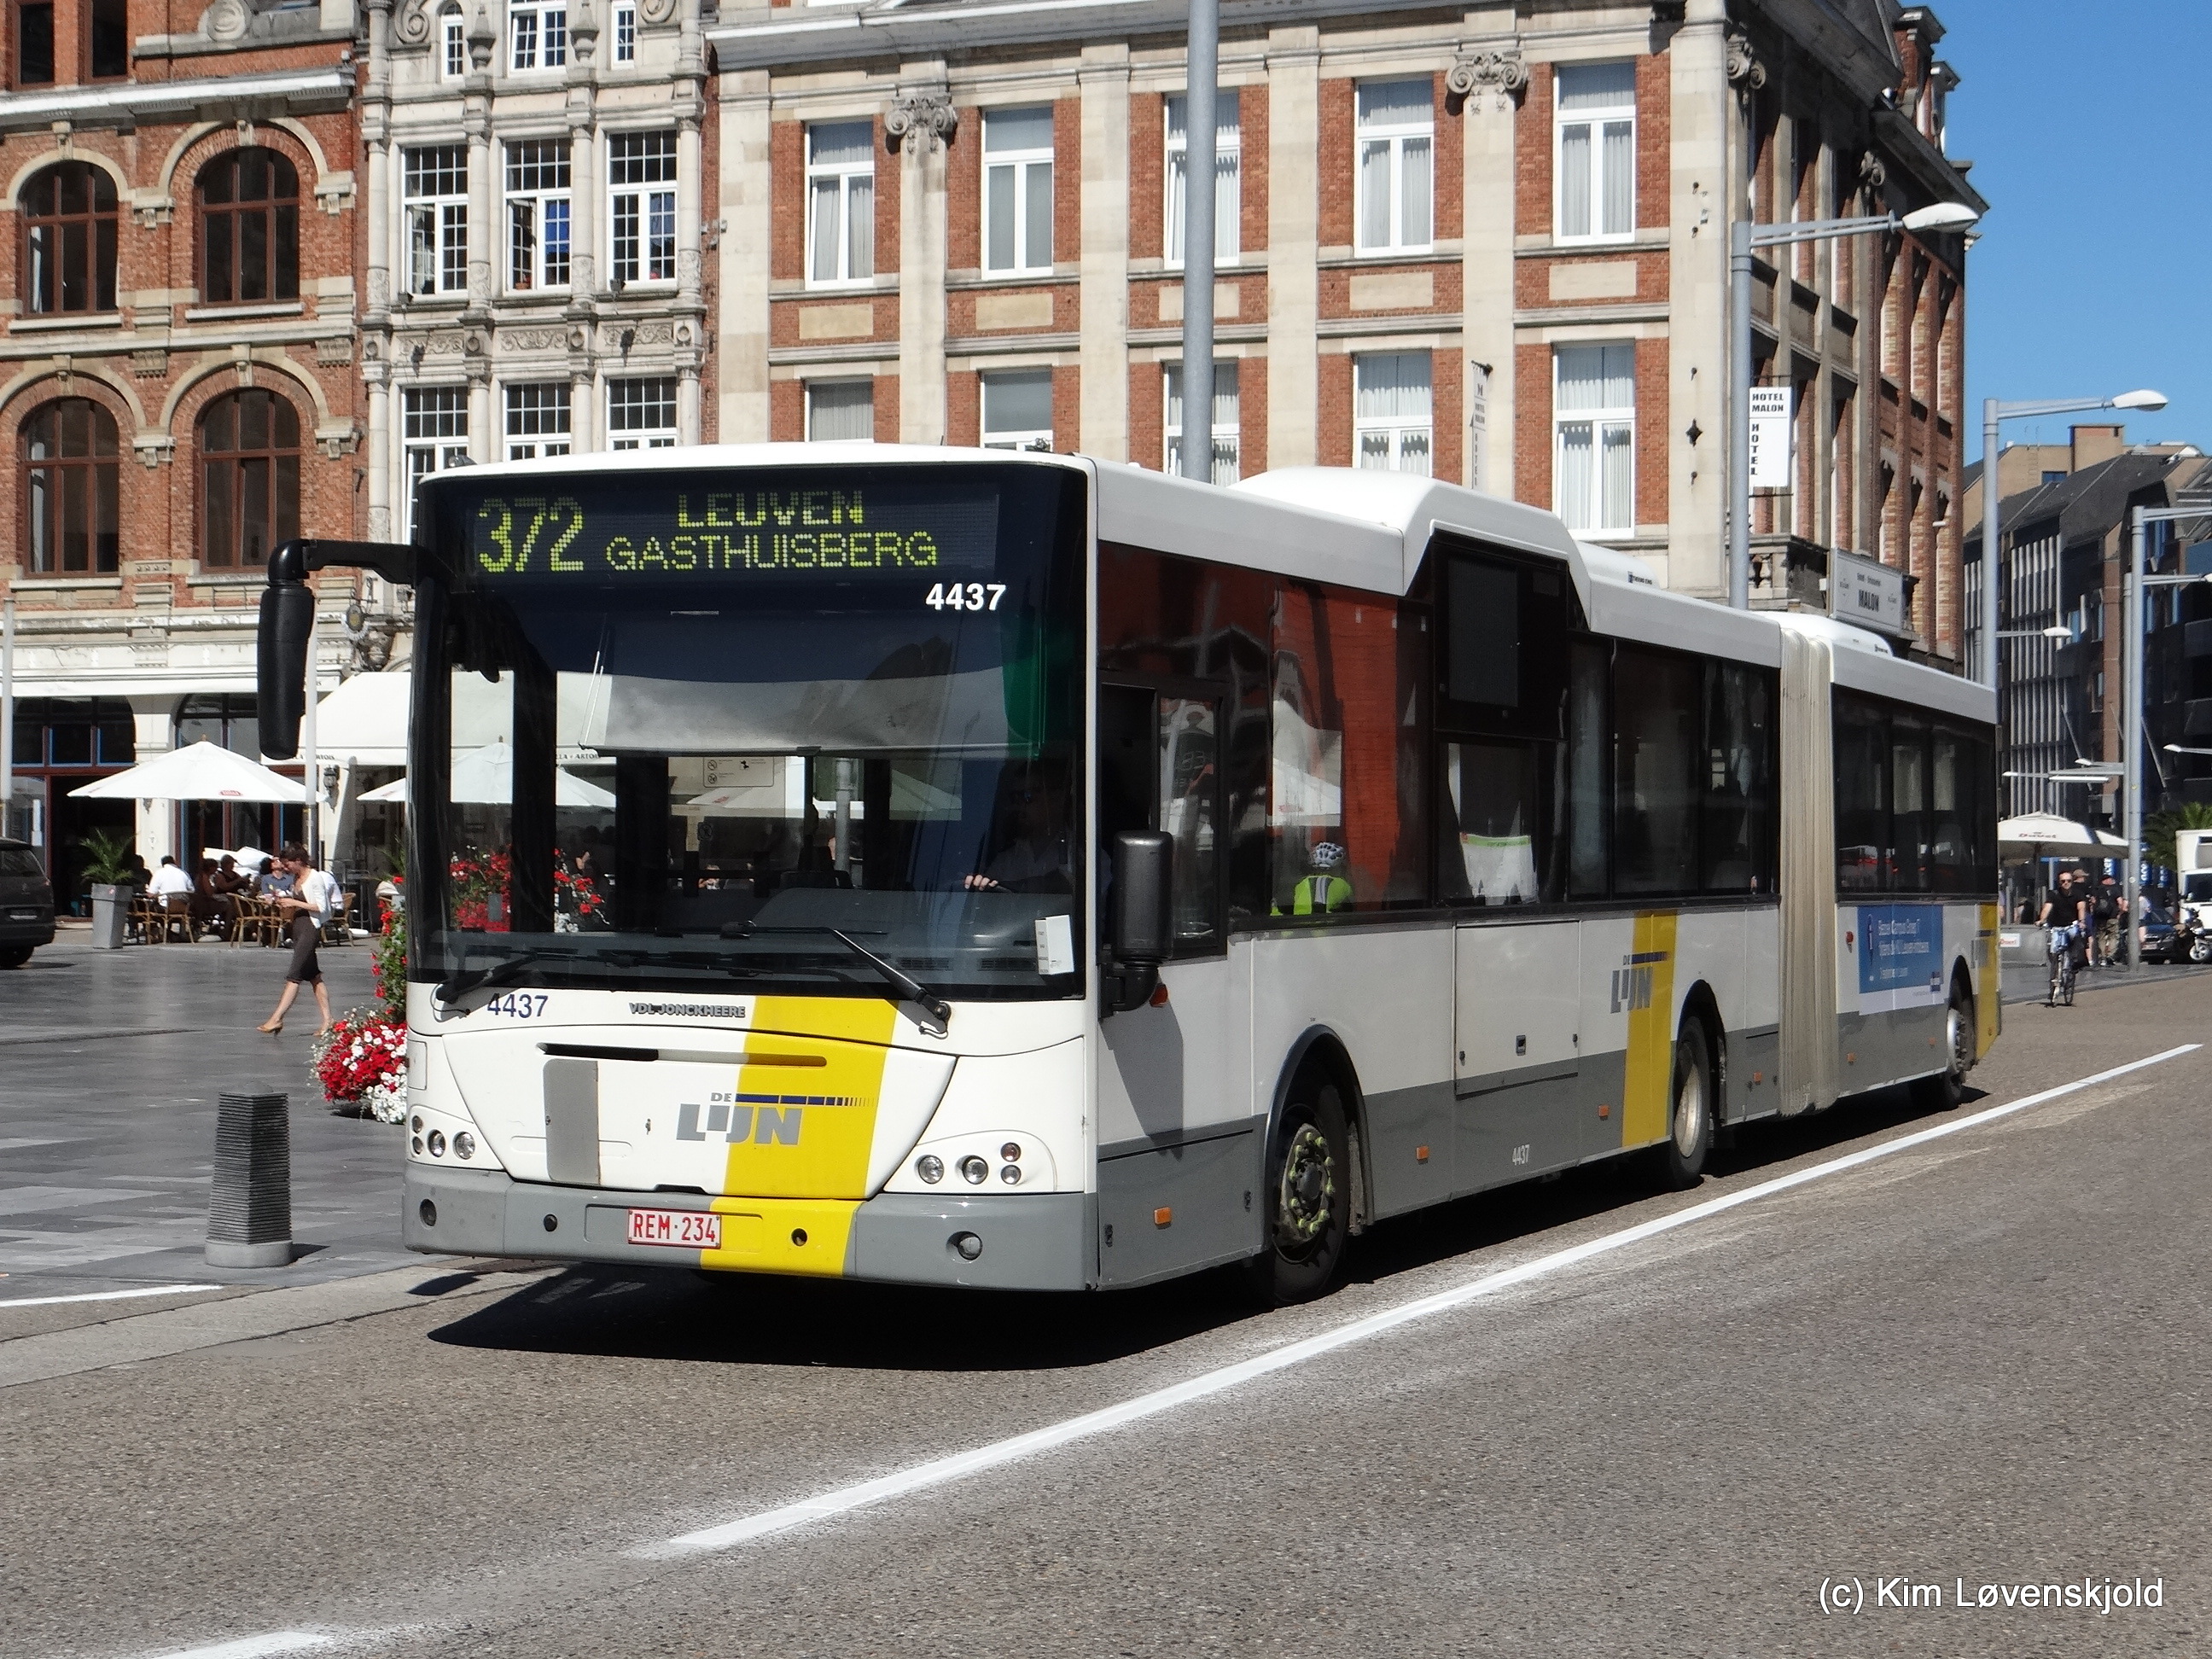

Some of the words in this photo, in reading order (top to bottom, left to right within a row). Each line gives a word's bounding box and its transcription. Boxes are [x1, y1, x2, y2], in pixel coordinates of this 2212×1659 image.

[1750, 423, 1760, 475] HOTEL
[678, 491, 864, 527] LEUVEN
[479, 498, 585, 573] 372
[605, 530, 939, 571] GASTHUISBERG
[924, 583, 1007, 611] 4437
[487, 992, 549, 1019] 4437
[629, 1002, 655, 1015] VDL
[657, 1003, 746, 1018] JONCKHEERE
[711, 1091, 732, 1103] DE
[676, 1103, 803, 1146] LIJN
[1511, 1144, 1530, 1166] 4437
